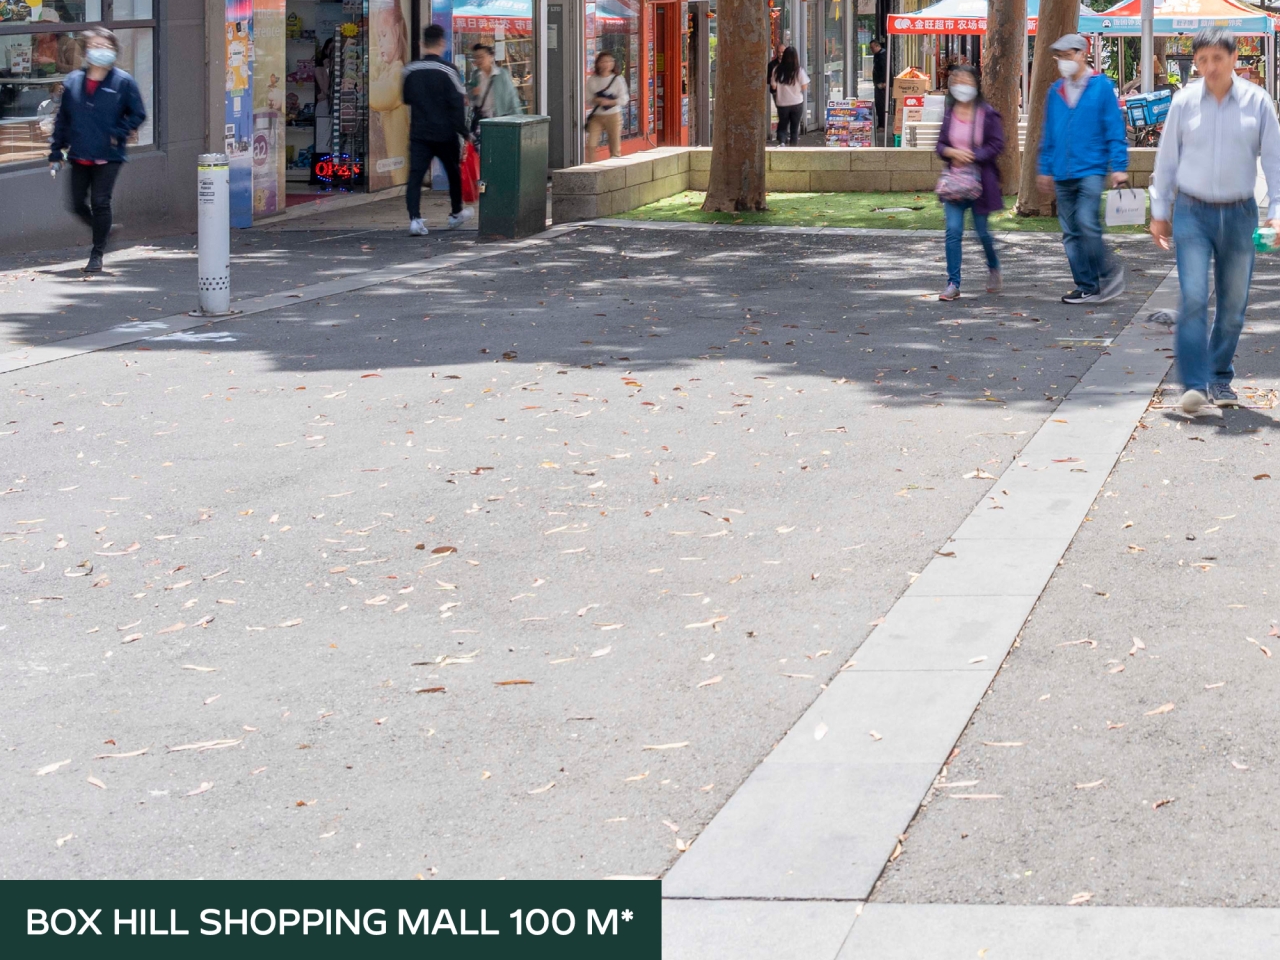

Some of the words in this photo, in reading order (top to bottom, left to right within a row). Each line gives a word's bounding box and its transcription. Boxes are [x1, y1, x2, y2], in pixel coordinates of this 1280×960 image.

[914, 19, 954, 30] 金旺超市
[253, 144, 268, 158] a2
